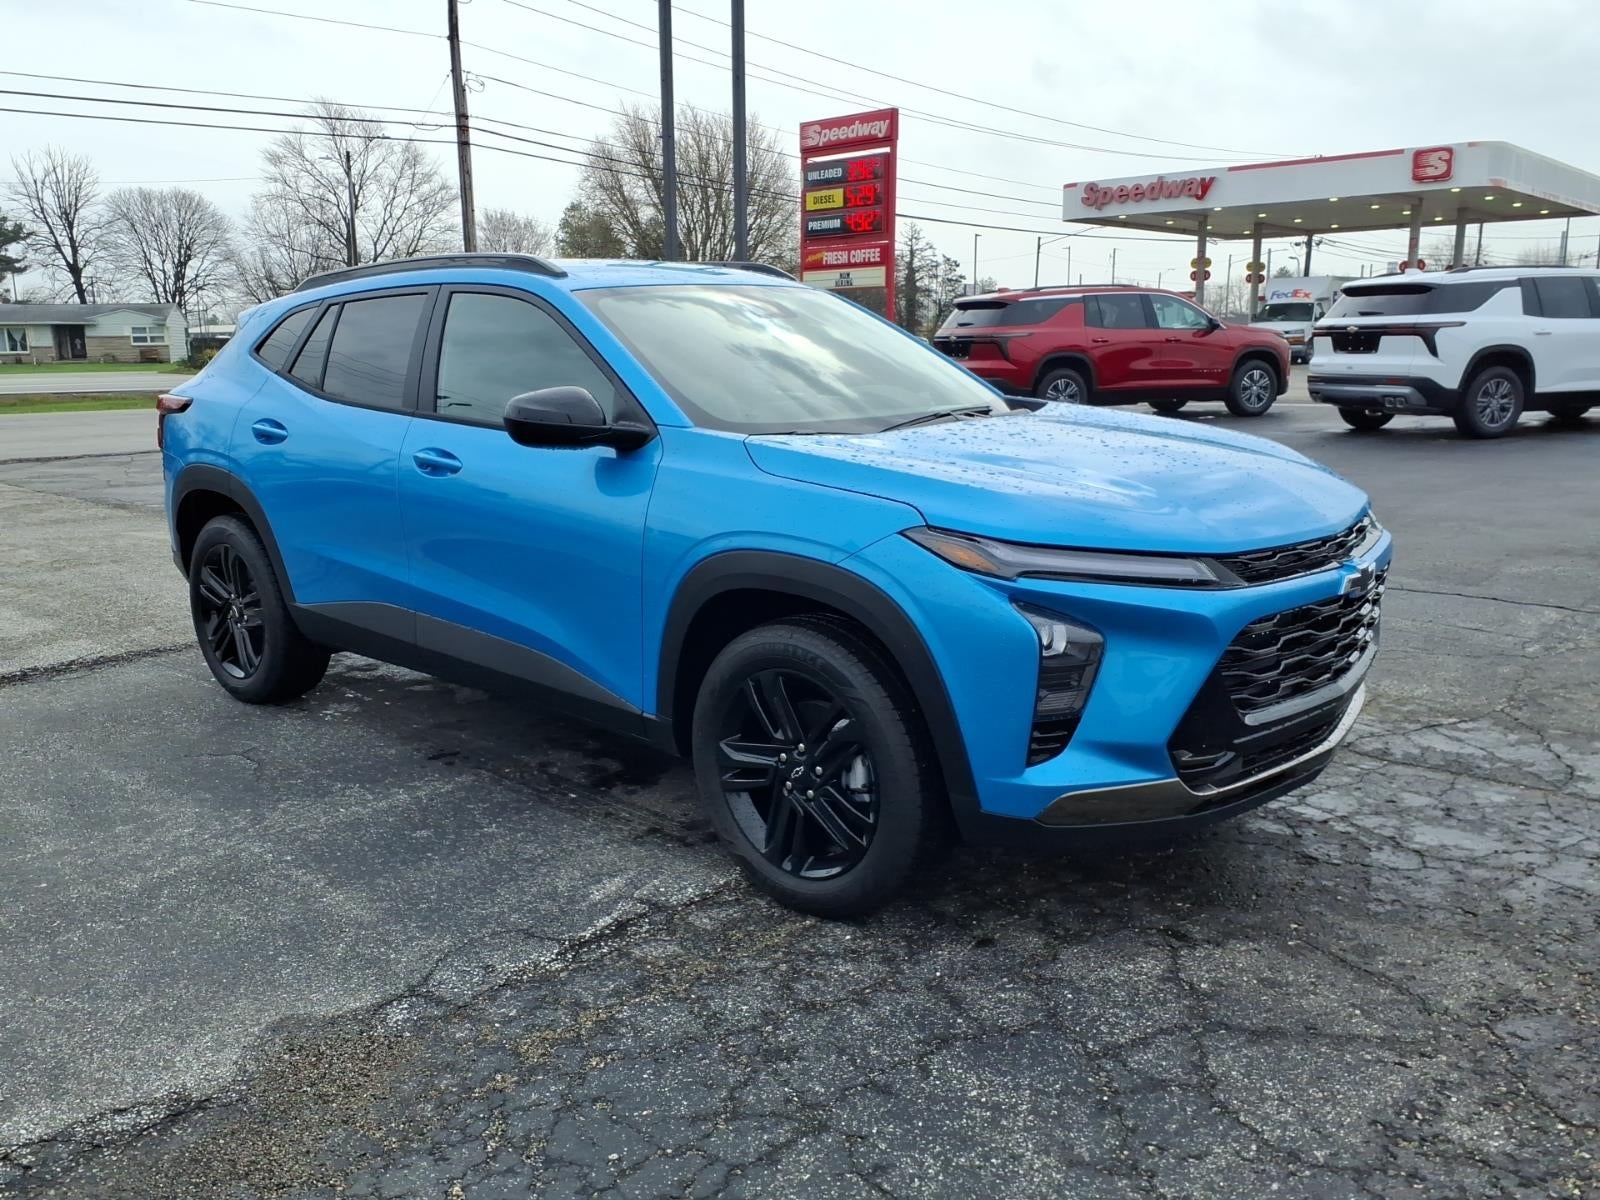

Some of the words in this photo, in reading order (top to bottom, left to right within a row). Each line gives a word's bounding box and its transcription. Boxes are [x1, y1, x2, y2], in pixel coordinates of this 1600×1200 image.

[804, 119, 889, 146] Speedway
[807, 168, 842, 180] UNLEADED
[1081, 175, 1216, 210] Speedway
[813, 195, 836, 205] DIESEL
[808, 219, 841, 231] PREMIUM
[822, 251, 849, 265] FRESH
[849, 247, 881, 264] COFFEE
[1270, 288, 1313, 300] FedEx
